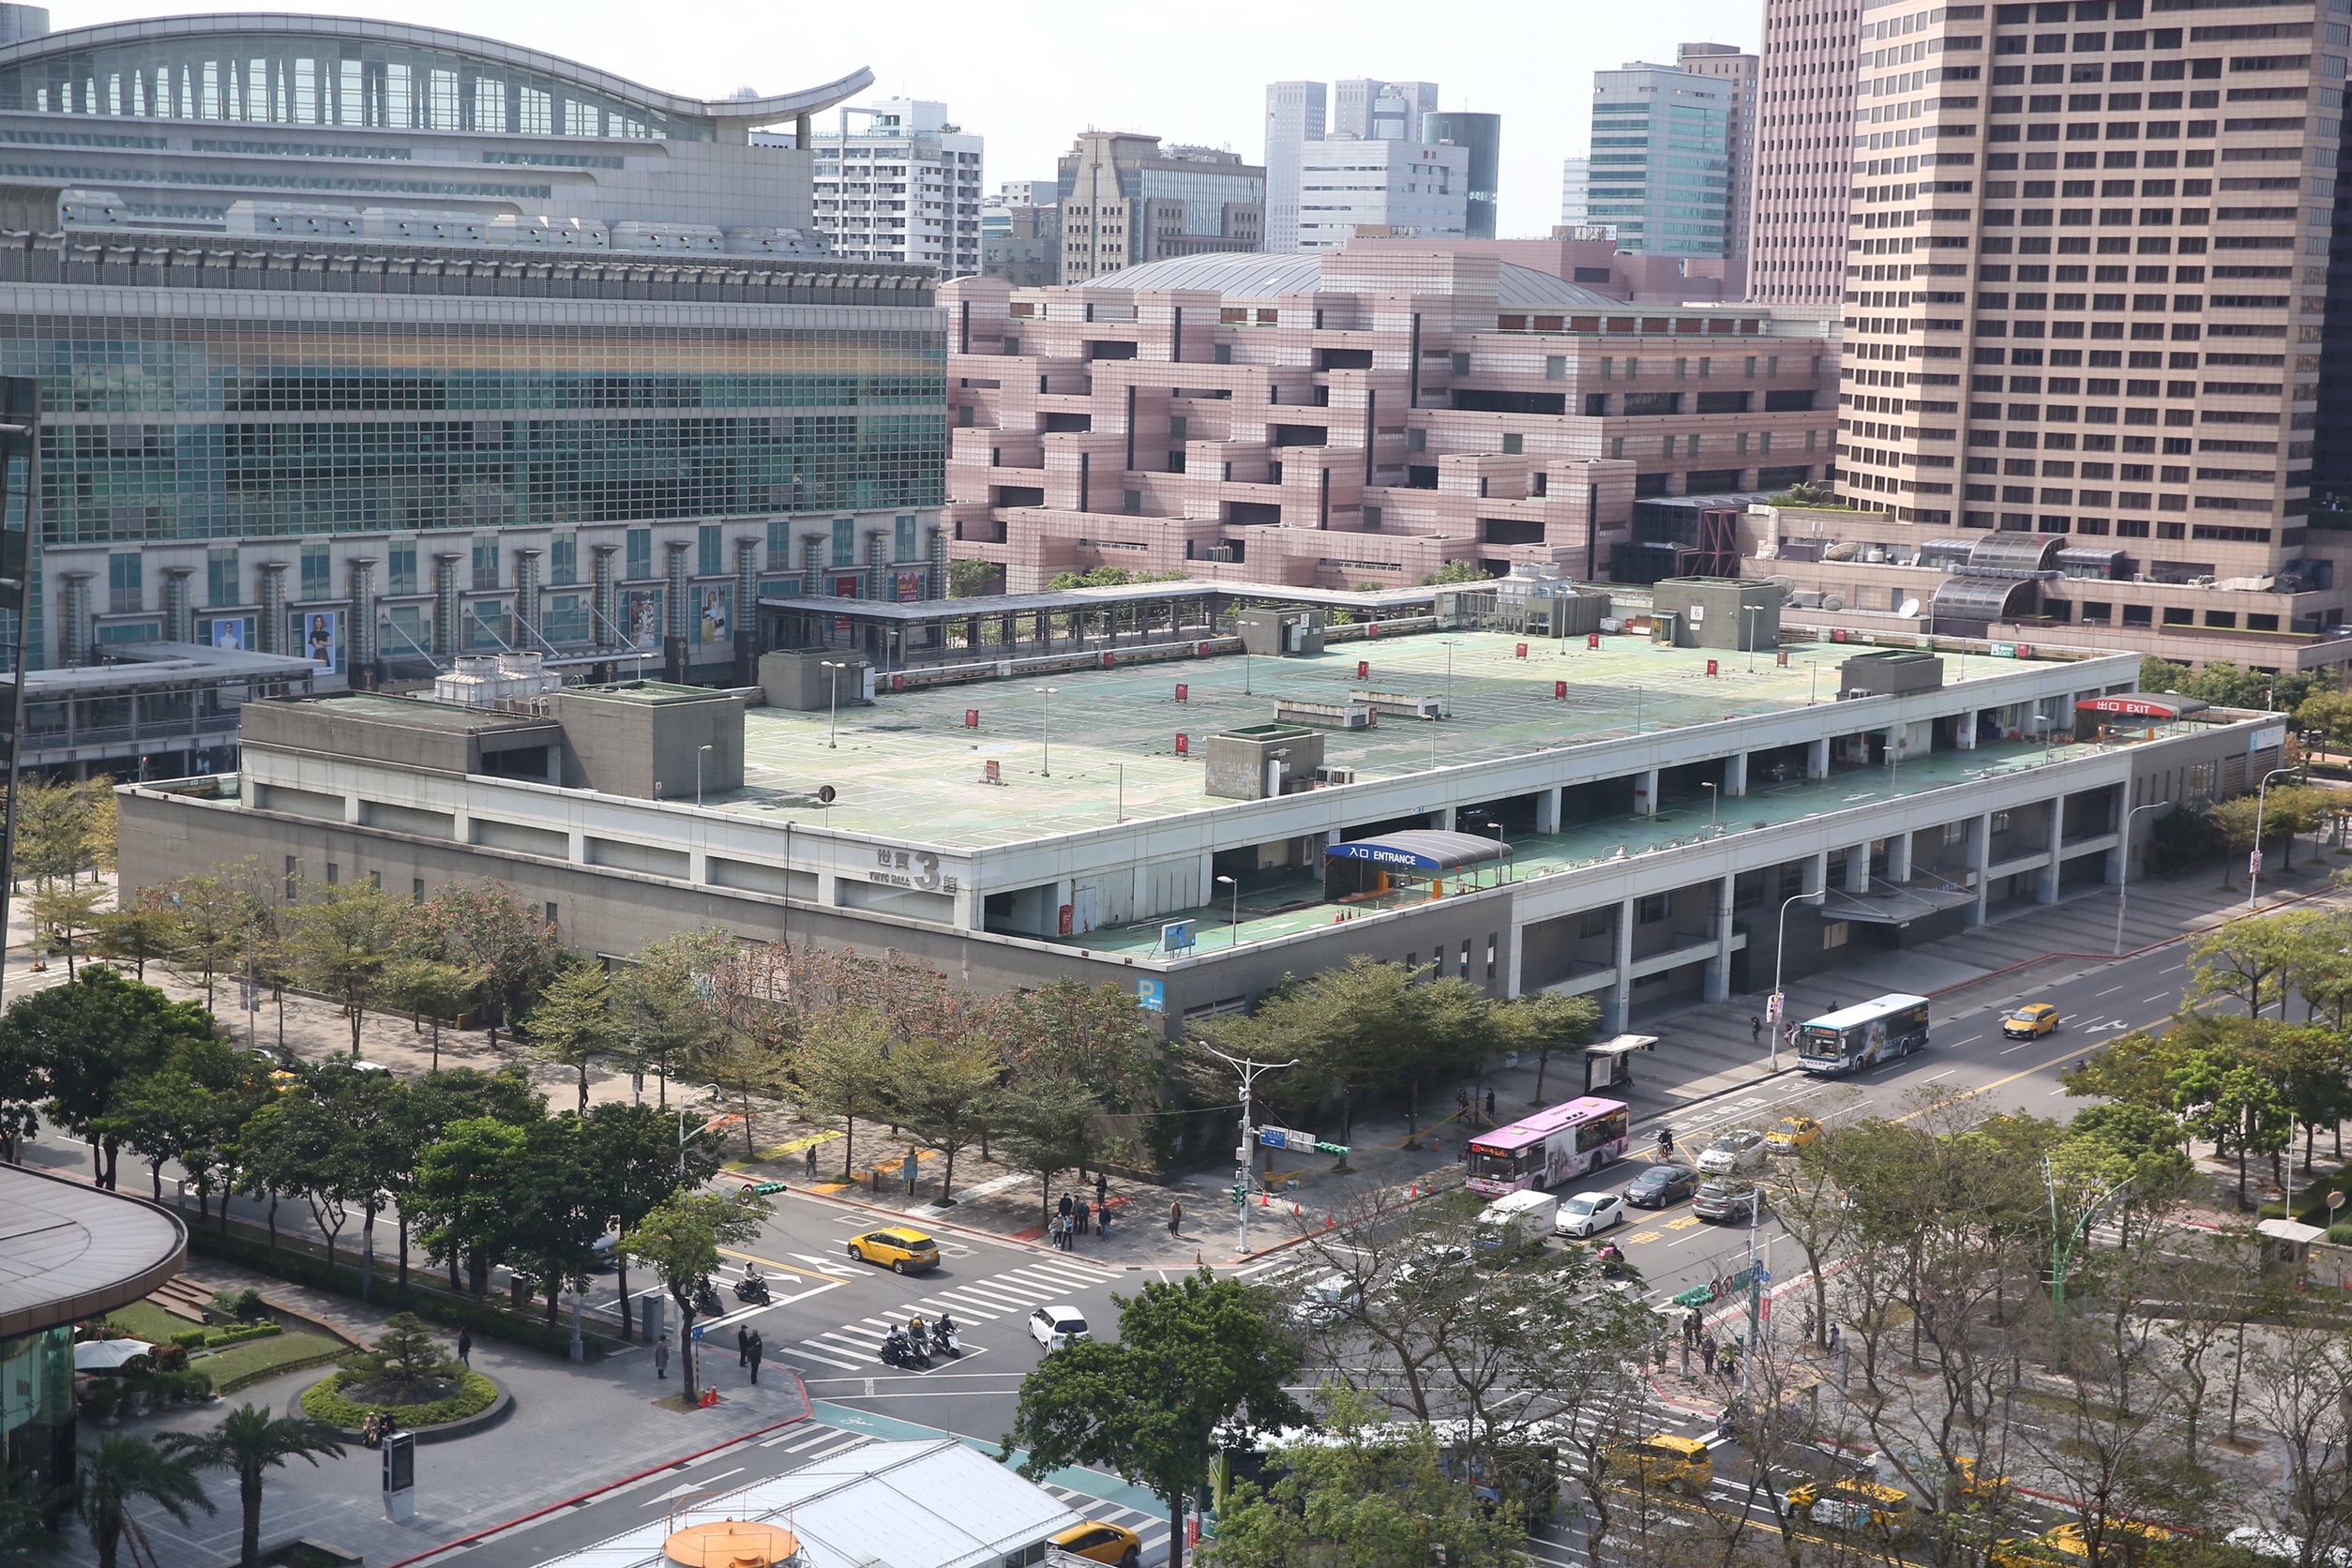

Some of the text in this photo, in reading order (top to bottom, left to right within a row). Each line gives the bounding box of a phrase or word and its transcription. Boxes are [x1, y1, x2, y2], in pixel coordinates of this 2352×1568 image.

[2097, 701, 2150, 714] 出口 EXIT
[1349, 847, 1416, 865] 入口 ENTRANCE
[914, 852, 940, 890] 3
[1139, 980, 1154, 1003] P
